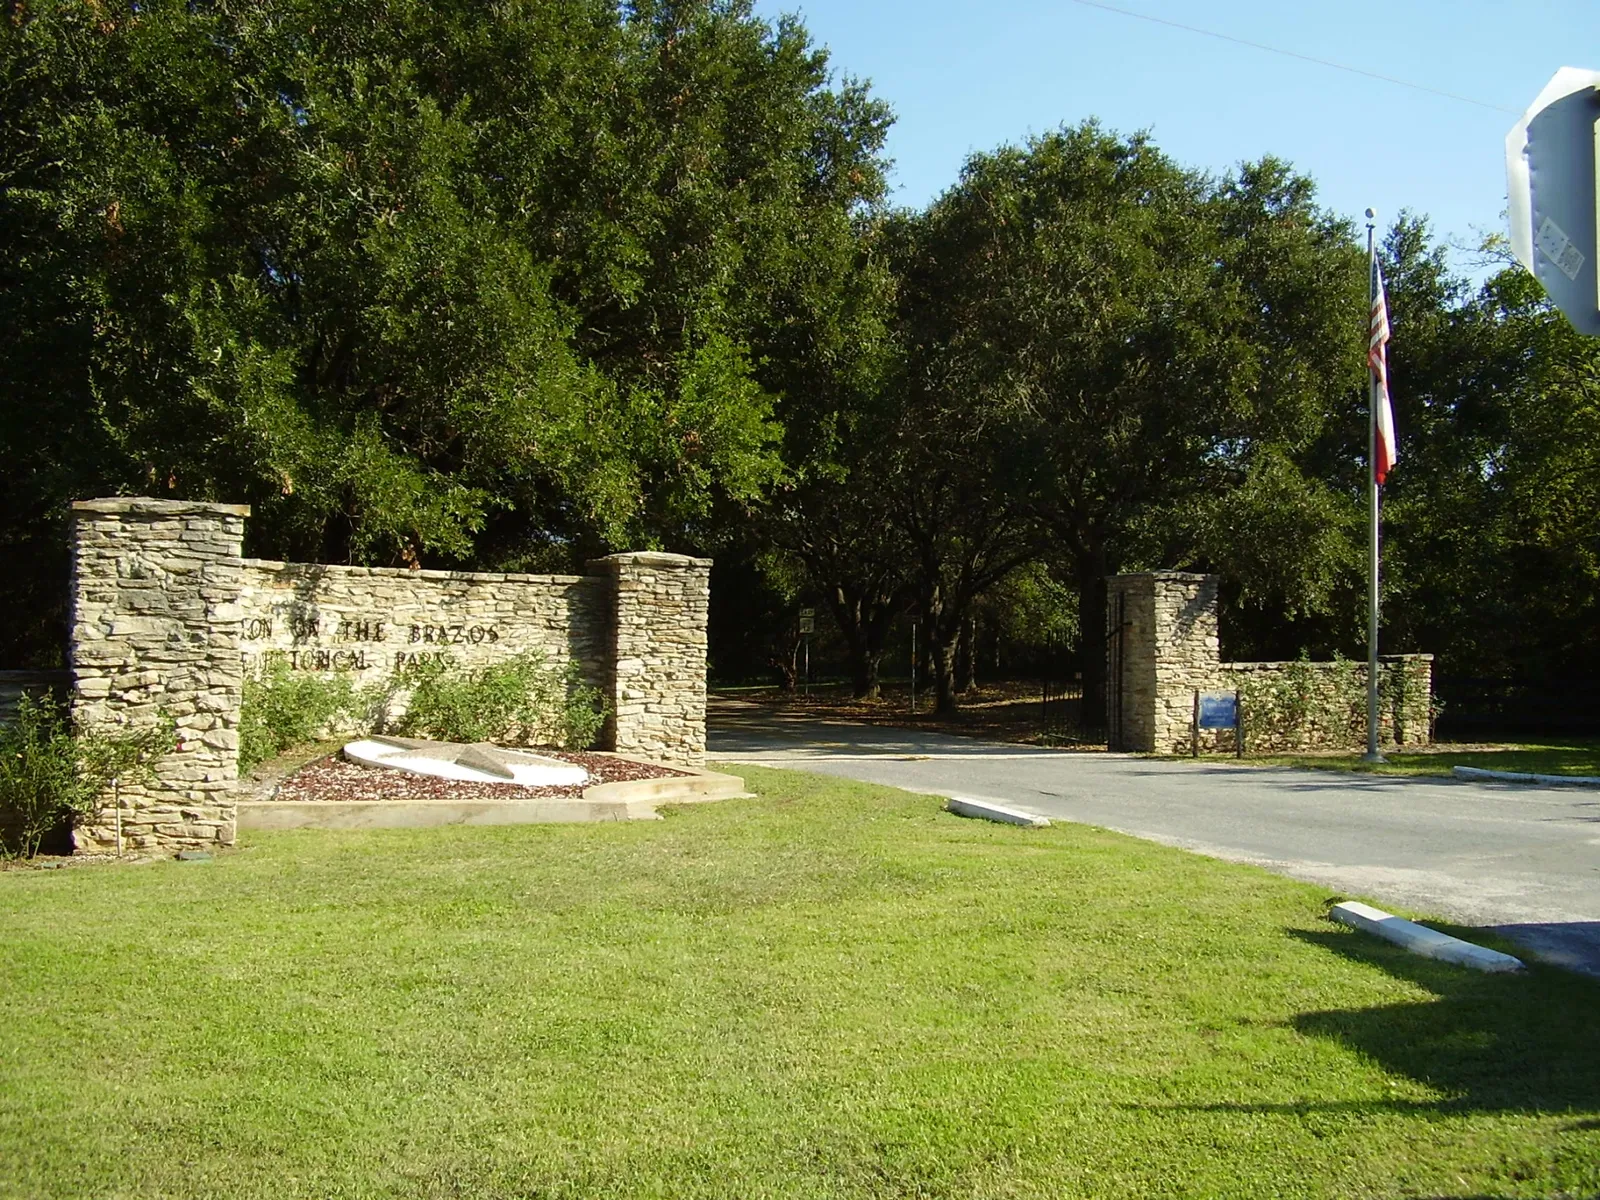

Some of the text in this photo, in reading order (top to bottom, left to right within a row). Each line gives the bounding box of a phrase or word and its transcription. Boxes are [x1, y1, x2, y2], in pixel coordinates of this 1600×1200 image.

[292, 617, 320, 638] ON
[343, 621, 386, 642] THE
[407, 623, 500, 645] BRAZOS
